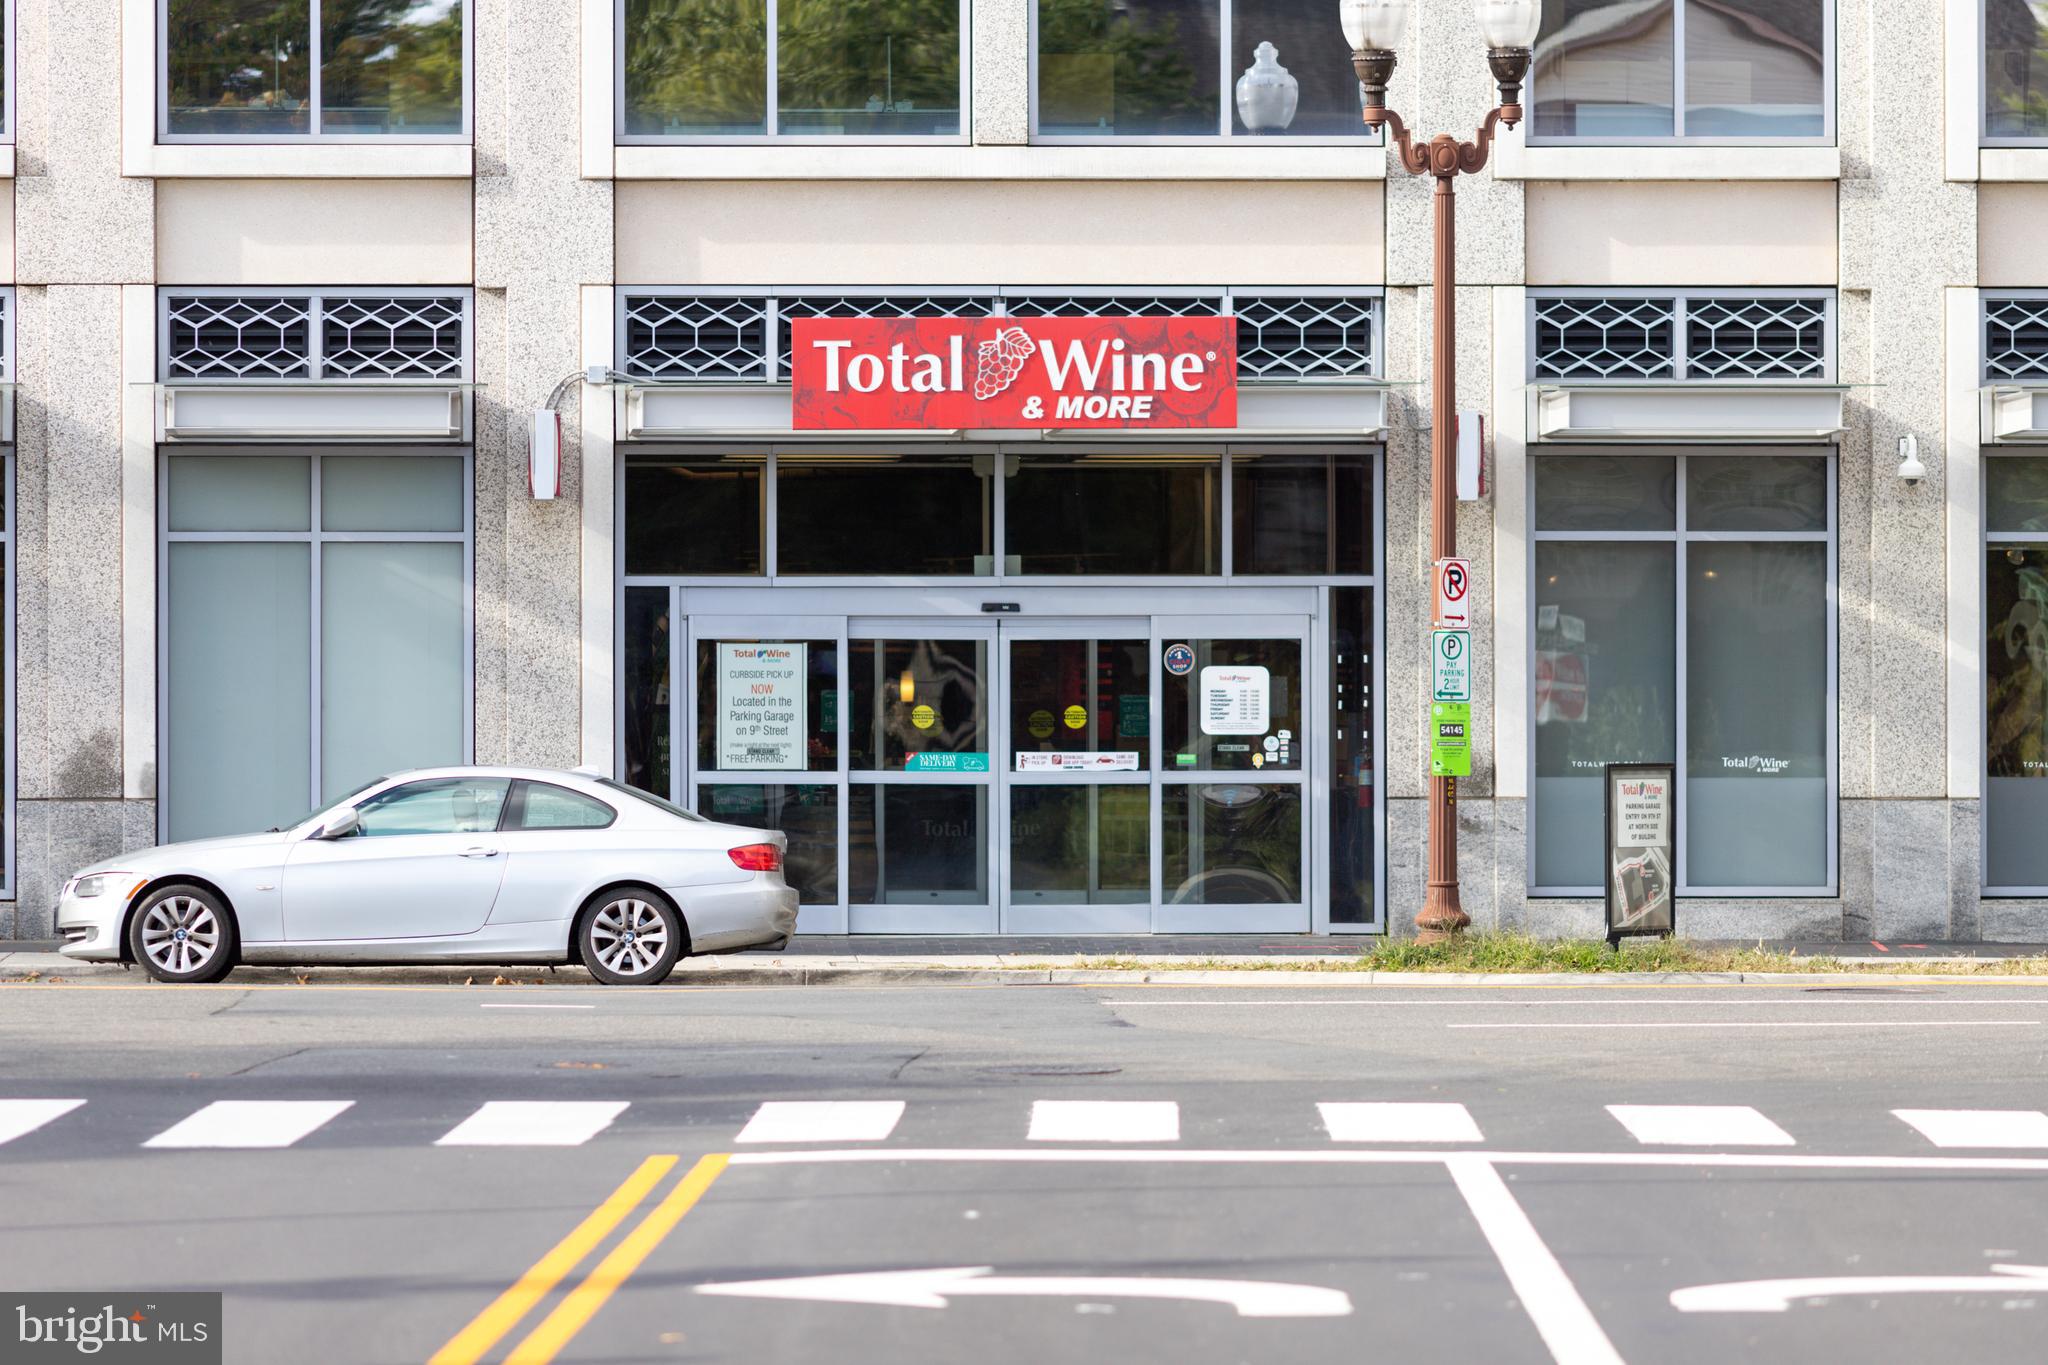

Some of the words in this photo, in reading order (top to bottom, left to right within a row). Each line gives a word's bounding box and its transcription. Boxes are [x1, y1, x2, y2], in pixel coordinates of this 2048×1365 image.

[812, 335, 963, 392] Total
[1022, 396, 1044, 419] &
[1056, 396, 1153, 419] MORE
[733, 649, 756, 658] Total
[765, 649, 791, 658] Wine
[1446, 661, 1457, 669] PAY
[730, 670, 764, 679] CURBSIDE
[766, 670, 782, 679] PICK
[784, 670, 794, 679] UP
[1440, 669, 1464, 677] PARKING
[751, 684, 774, 694] NOW
[1444, 678, 1450, 690] 2
[732, 696, 765, 707] Located
[768, 696, 776, 707] in
[778, 696, 792, 707] the
[730, 710, 761, 723] Parking
[764, 710, 794, 723] Garage
[736, 727, 747, 736] on
[750, 725, 761, 736] 9th
[763, 725, 788, 736] Street
[1441, 725, 1463, 734] 54145
[1722, 756, 1748, 768] Total
[1760, 756, 1790, 768] Wine
[1622, 784, 1638, 795] Total
[1645, 784, 1662, 795] Wine
